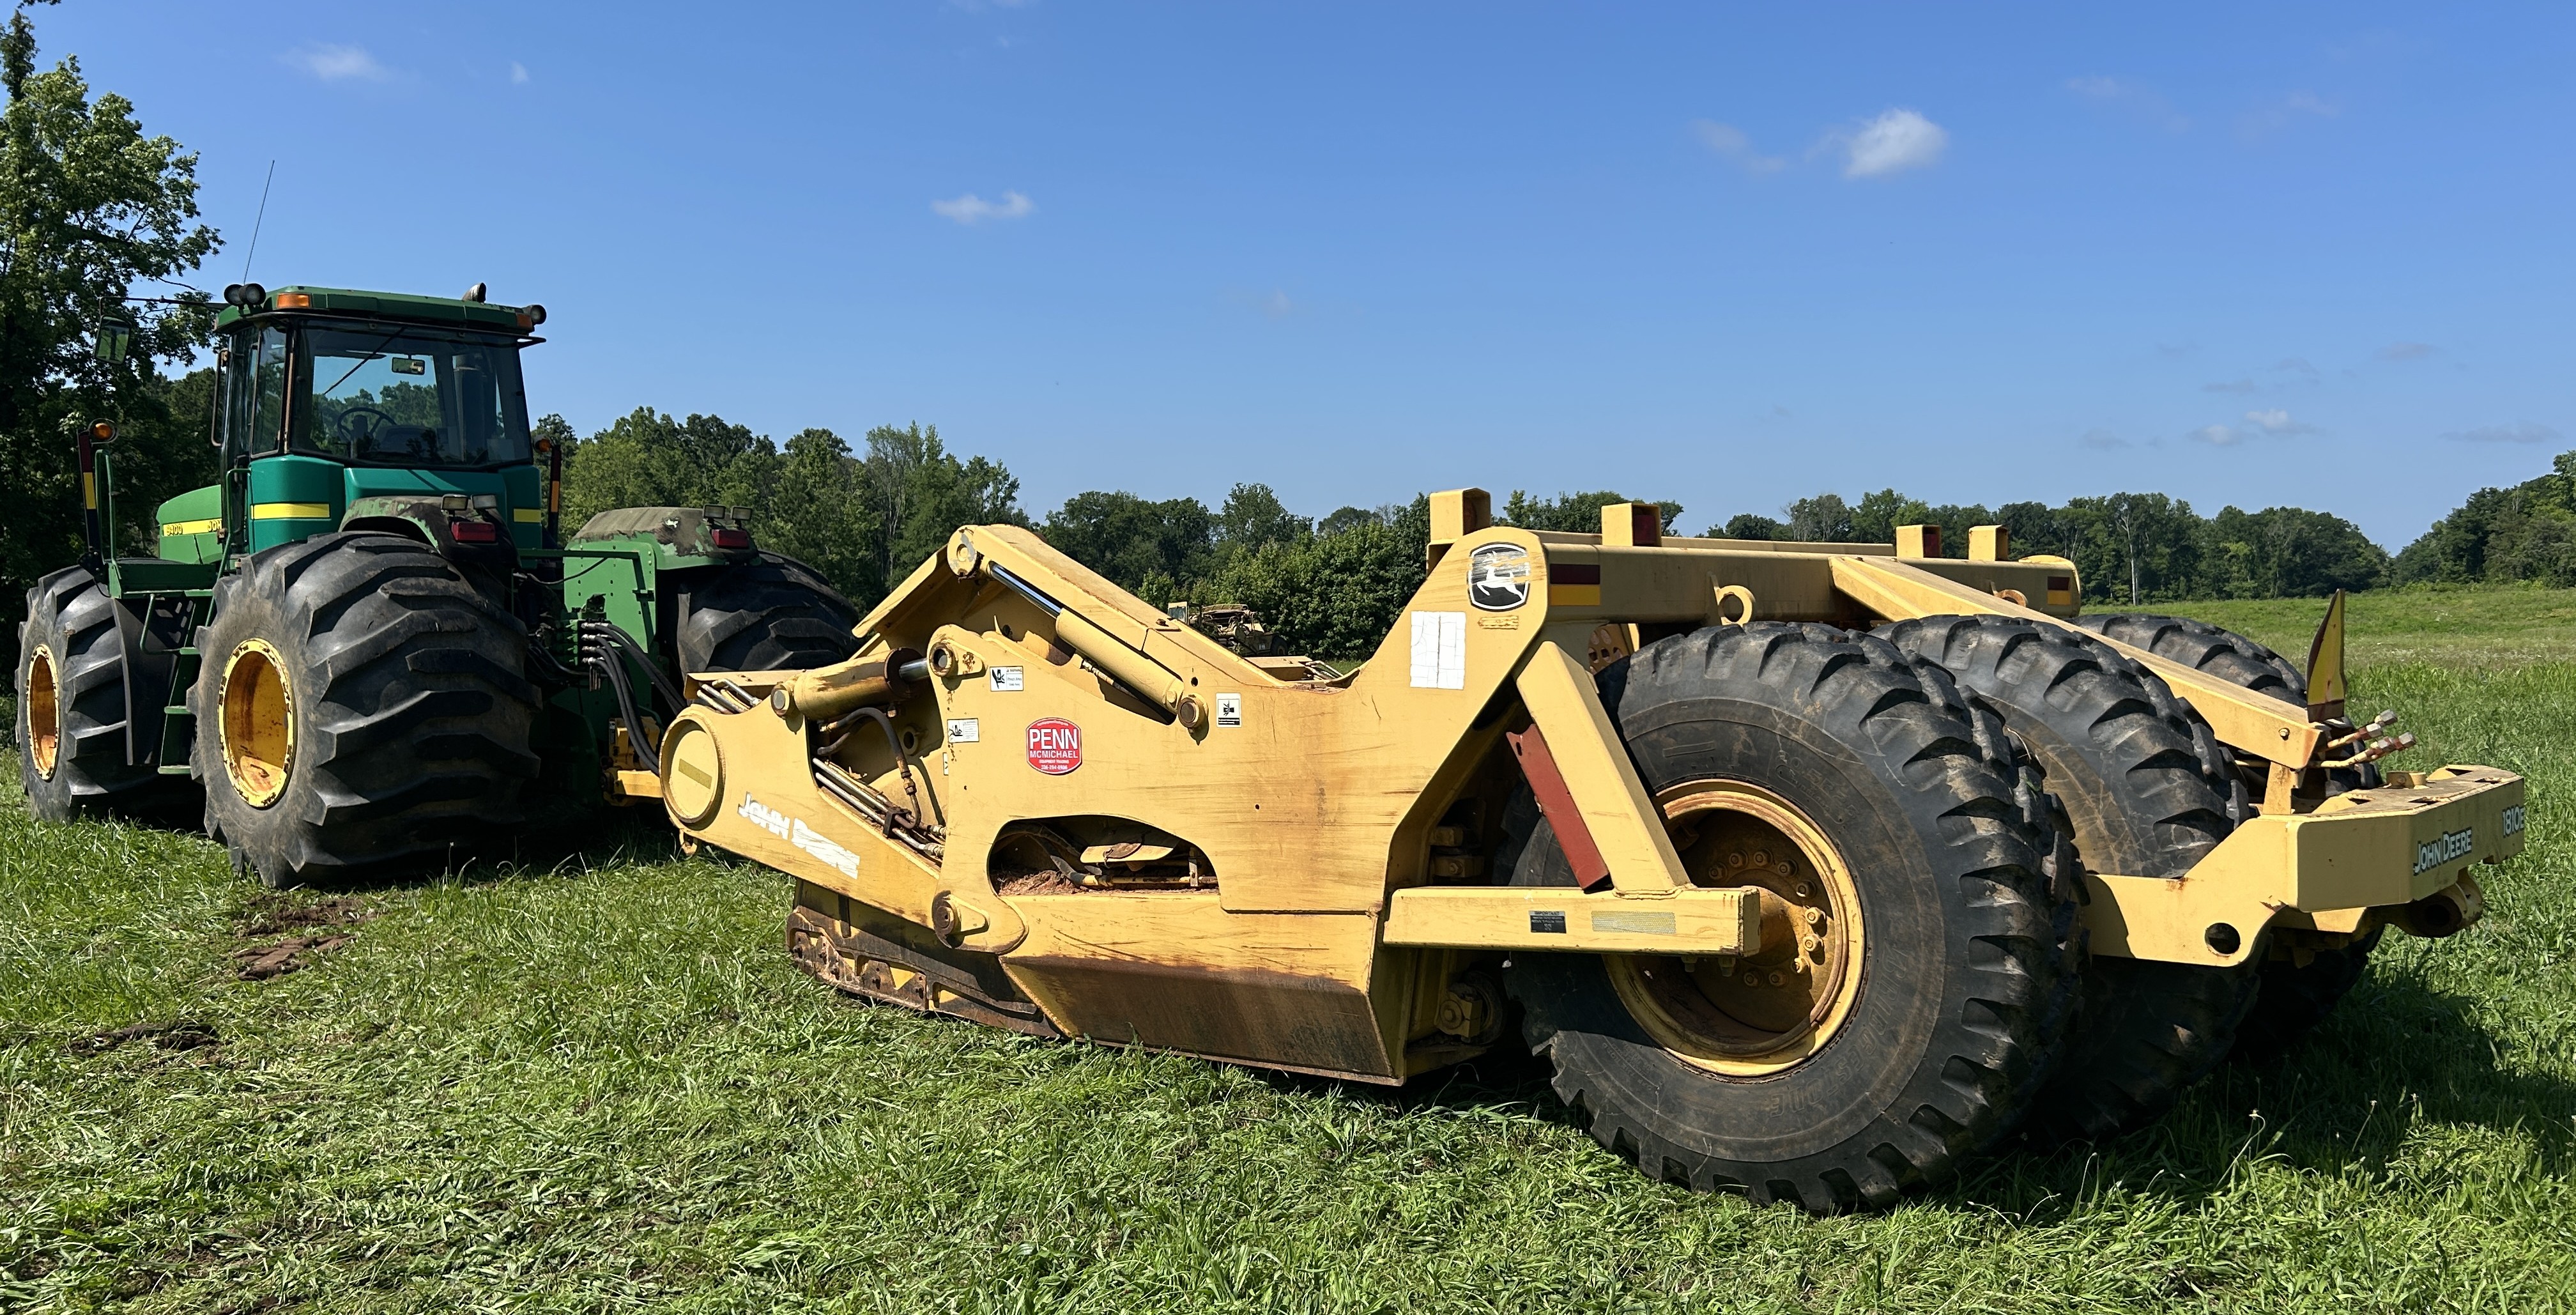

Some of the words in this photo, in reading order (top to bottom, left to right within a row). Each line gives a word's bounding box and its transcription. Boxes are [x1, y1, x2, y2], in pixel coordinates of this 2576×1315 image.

[208, 519, 222, 532] JOH
[1029, 728, 1078, 750] PENN
[1029, 750, 1078, 758] MCMICHAEL
[737, 791, 790, 840] JOHN
[2413, 840, 2441, 875] JOHN
[2442, 828, 2472, 862] DEERE
[1769, 937, 1909, 1118] BRIDGESTONE
